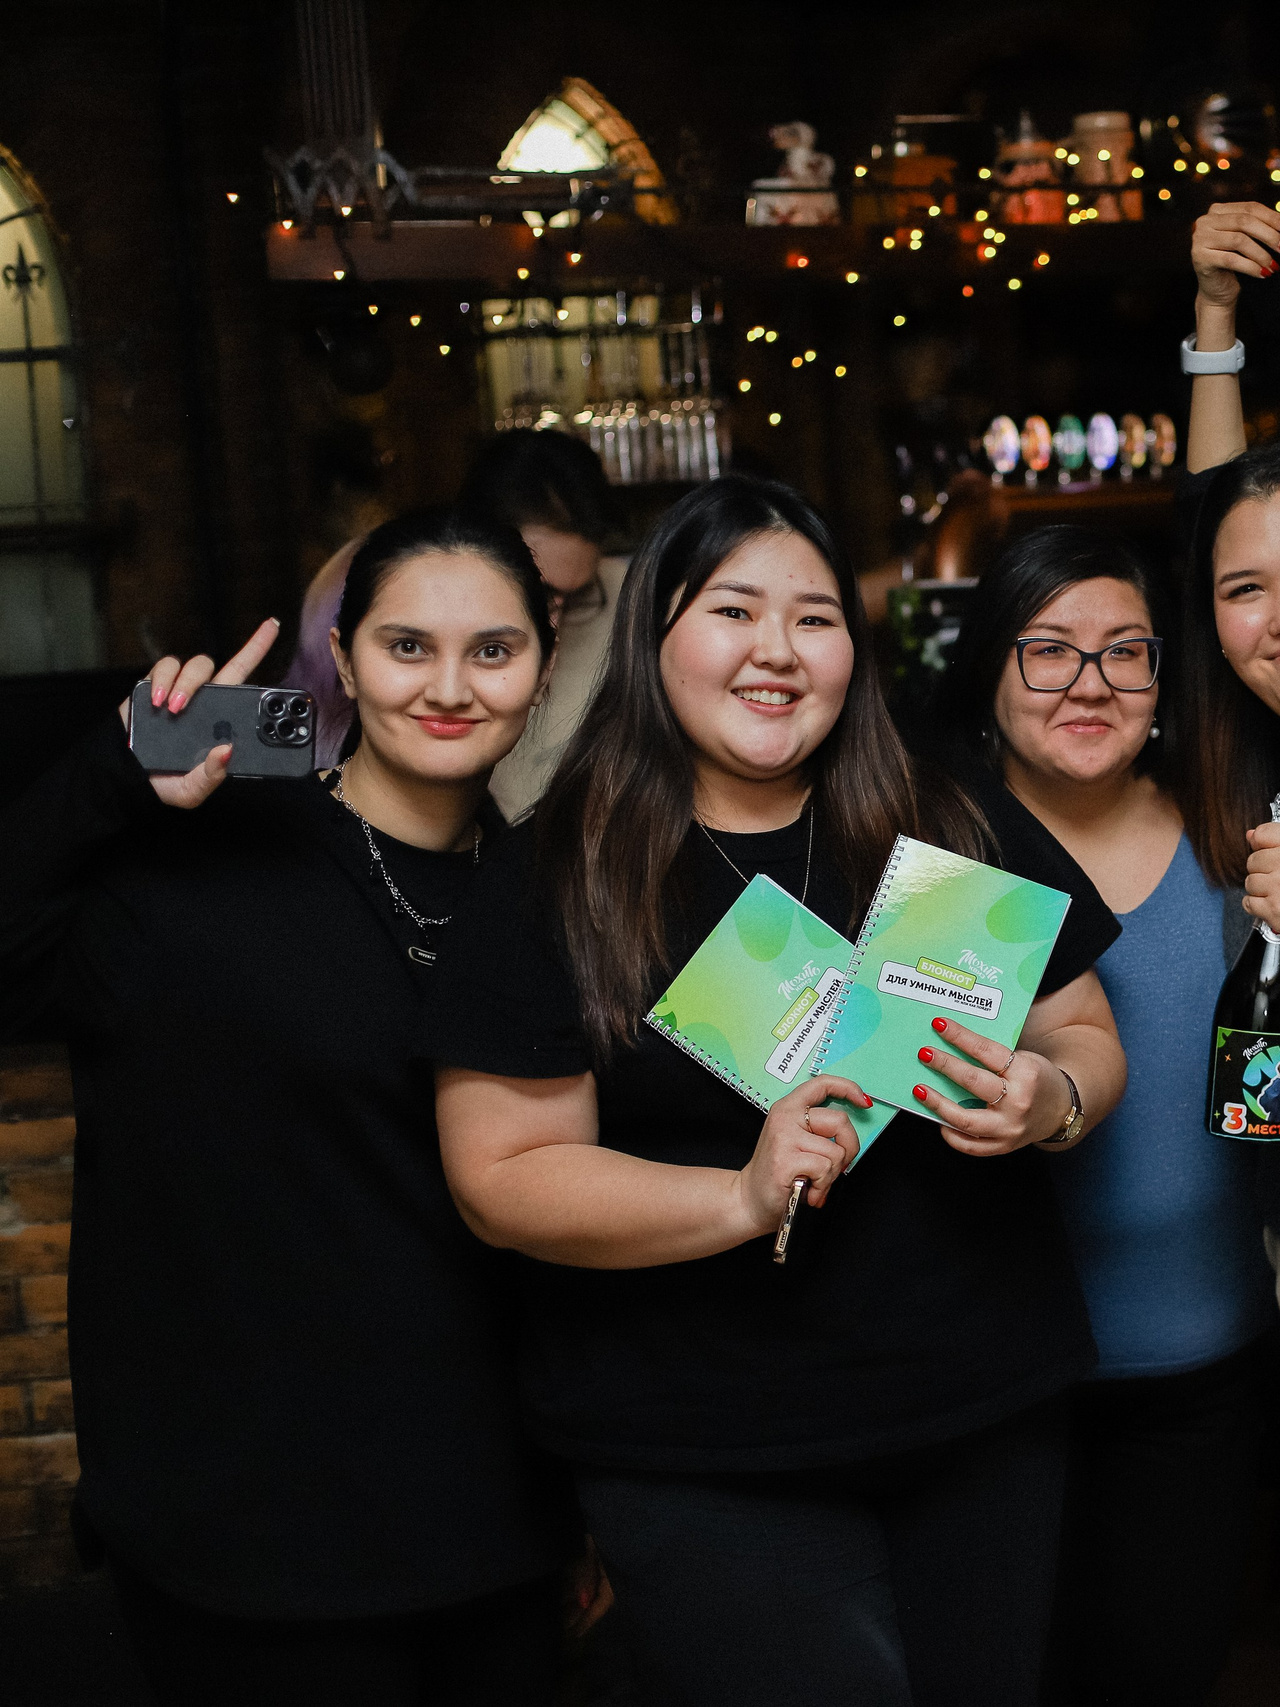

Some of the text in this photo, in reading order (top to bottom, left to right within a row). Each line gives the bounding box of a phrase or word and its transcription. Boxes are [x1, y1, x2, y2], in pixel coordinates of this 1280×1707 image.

[921, 961, 973, 985] БЛОКНОТ
[886, 974, 993, 1008] ДЛЯ УМНЫХ МЫСЛЕЙ
[777, 991, 814, 1037] БЛОКНОТ
[778, 1052, 794, 1074] ДЛЯ
[790, 1018, 816, 1053] УМНЫХ
[813, 979, 842, 1019] МЫСЛЕЙ
[1221, 1102, 1247, 1134] 3
